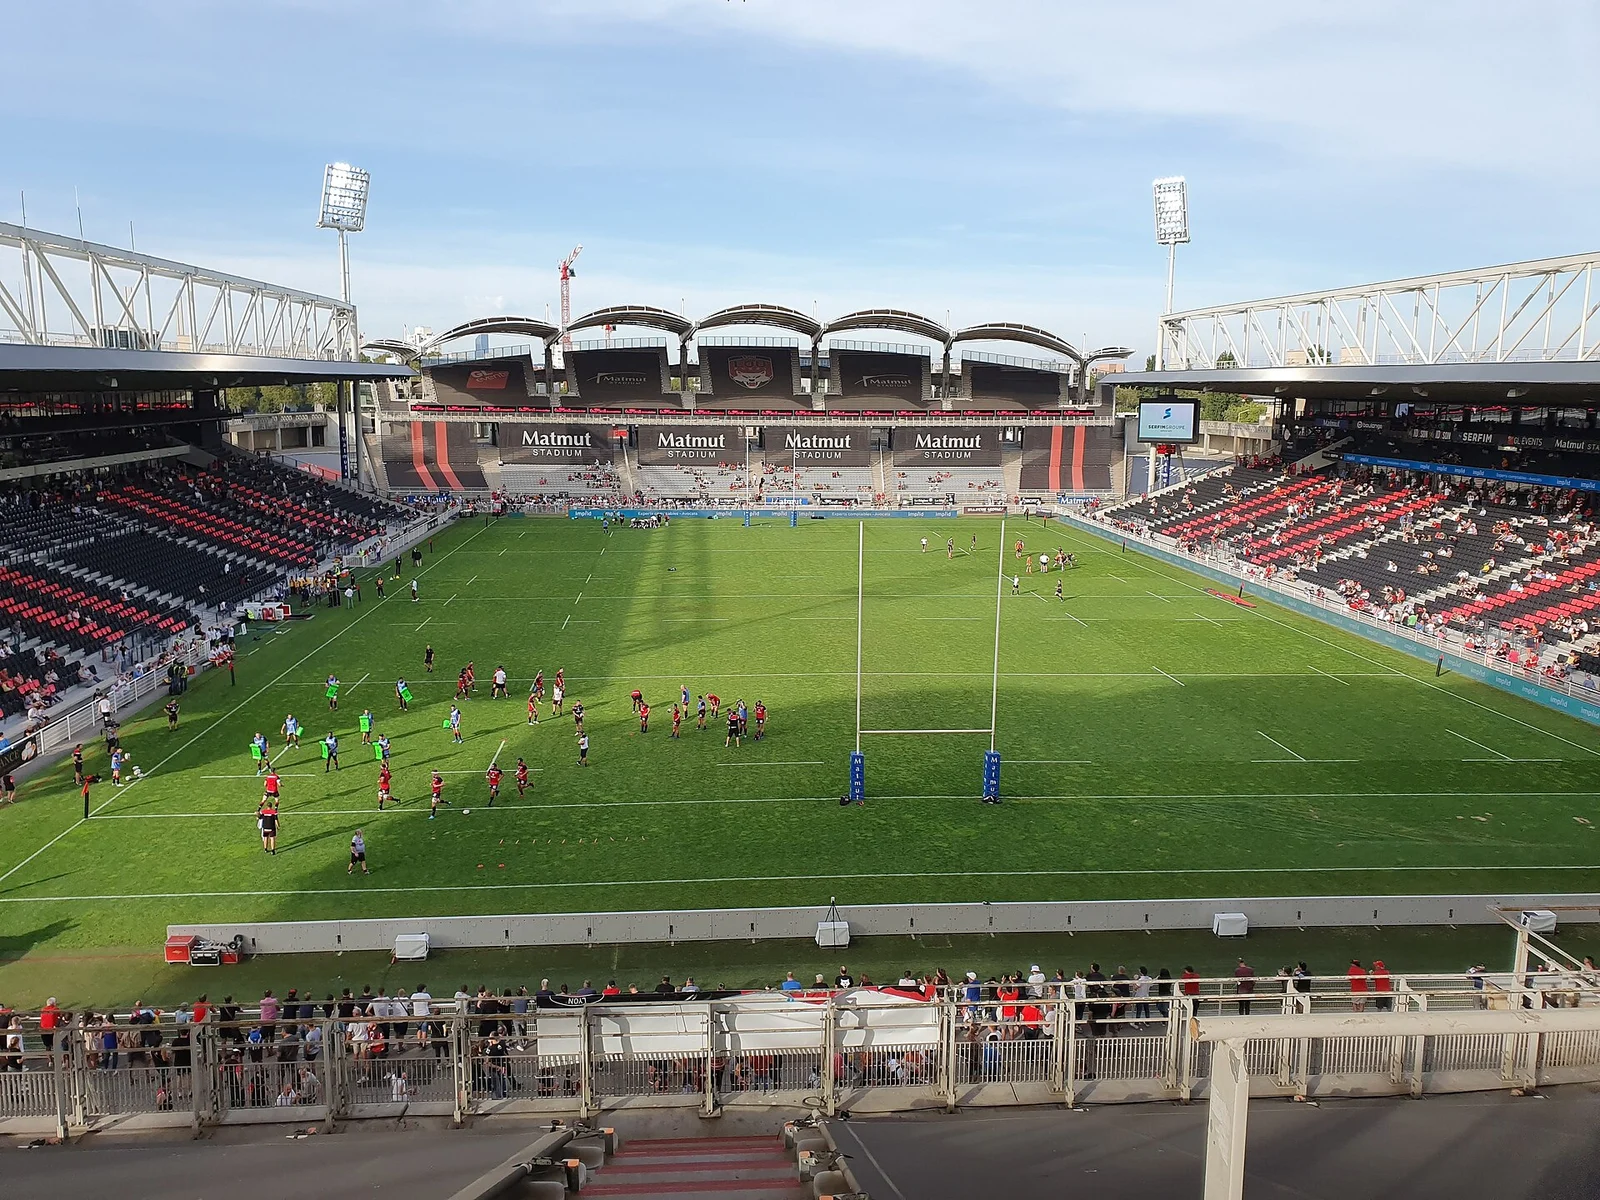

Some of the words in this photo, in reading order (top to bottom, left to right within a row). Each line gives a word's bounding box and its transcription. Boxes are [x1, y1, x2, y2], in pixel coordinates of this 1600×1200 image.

[521, 430, 591, 446] Matmut
[657, 433, 725, 447] Matmut
[785, 434, 851, 448] Matmut
[915, 434, 981, 448] Matmut
[1462, 432, 1493, 443] SERFIM
[1554, 439, 1585, 449] Matmut
[533, 449, 582, 457] STADIUM
[667, 450, 716, 458] STADIUM
[794, 451, 842, 459] STADIUM
[924, 451, 971, 459] STADIUM
[854, 758, 862, 800] Matmut
